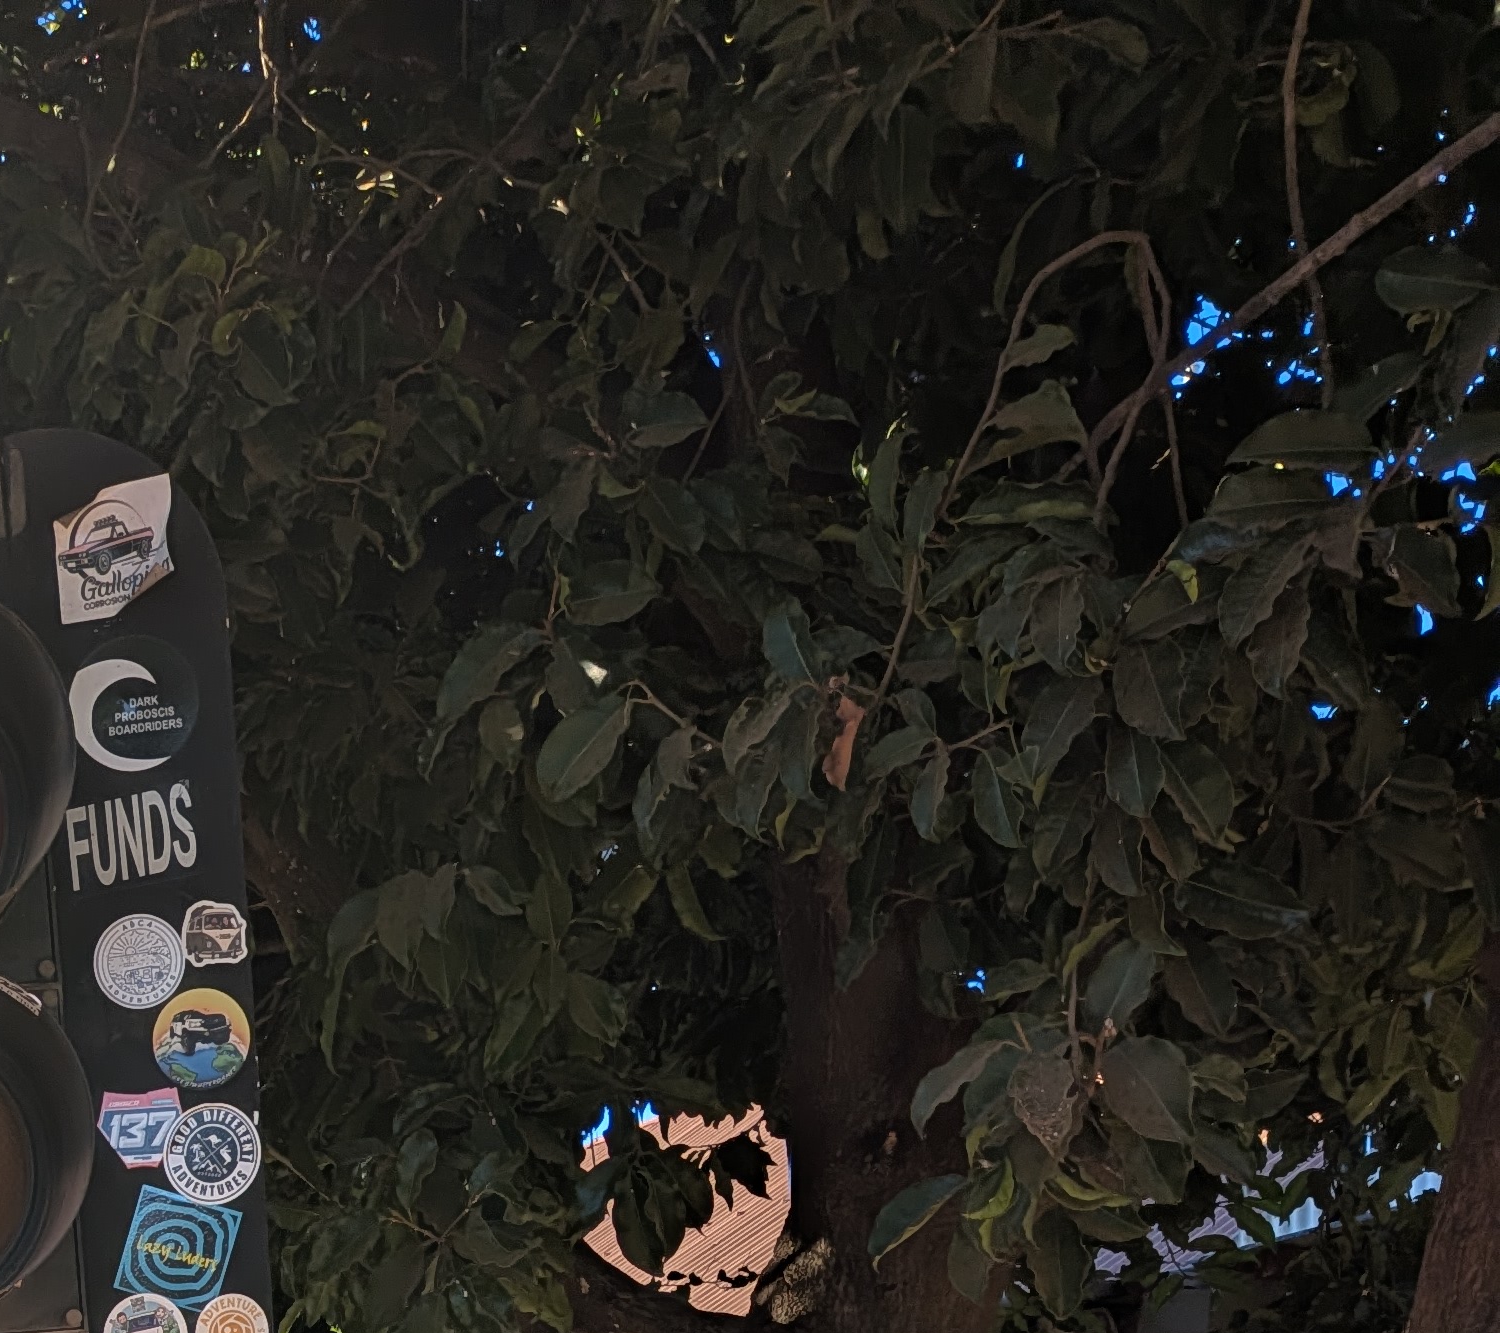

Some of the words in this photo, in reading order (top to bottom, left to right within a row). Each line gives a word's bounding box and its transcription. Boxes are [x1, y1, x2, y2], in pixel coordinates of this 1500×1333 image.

[84, 593, 132, 611] CORROSION
[114, 706, 175, 723] PROBOSCIS
[129, 695, 159, 708] DARK
[108, 717, 183, 737] BOARDRIDERS
[66, 783, 197, 892] FUNDS
[107, 974, 177, 1004] ADVENTURES
[110, 1111, 177, 1149] 137
[171, 1117, 198, 1154] GOOD
[202, 1109, 254, 1162] DIFFERENT
[171, 1164, 248, 1197] ADVENTURES
[137, 1235, 171, 1262] Lazy
[199, 1297, 263, 1327] ADVENTURE
